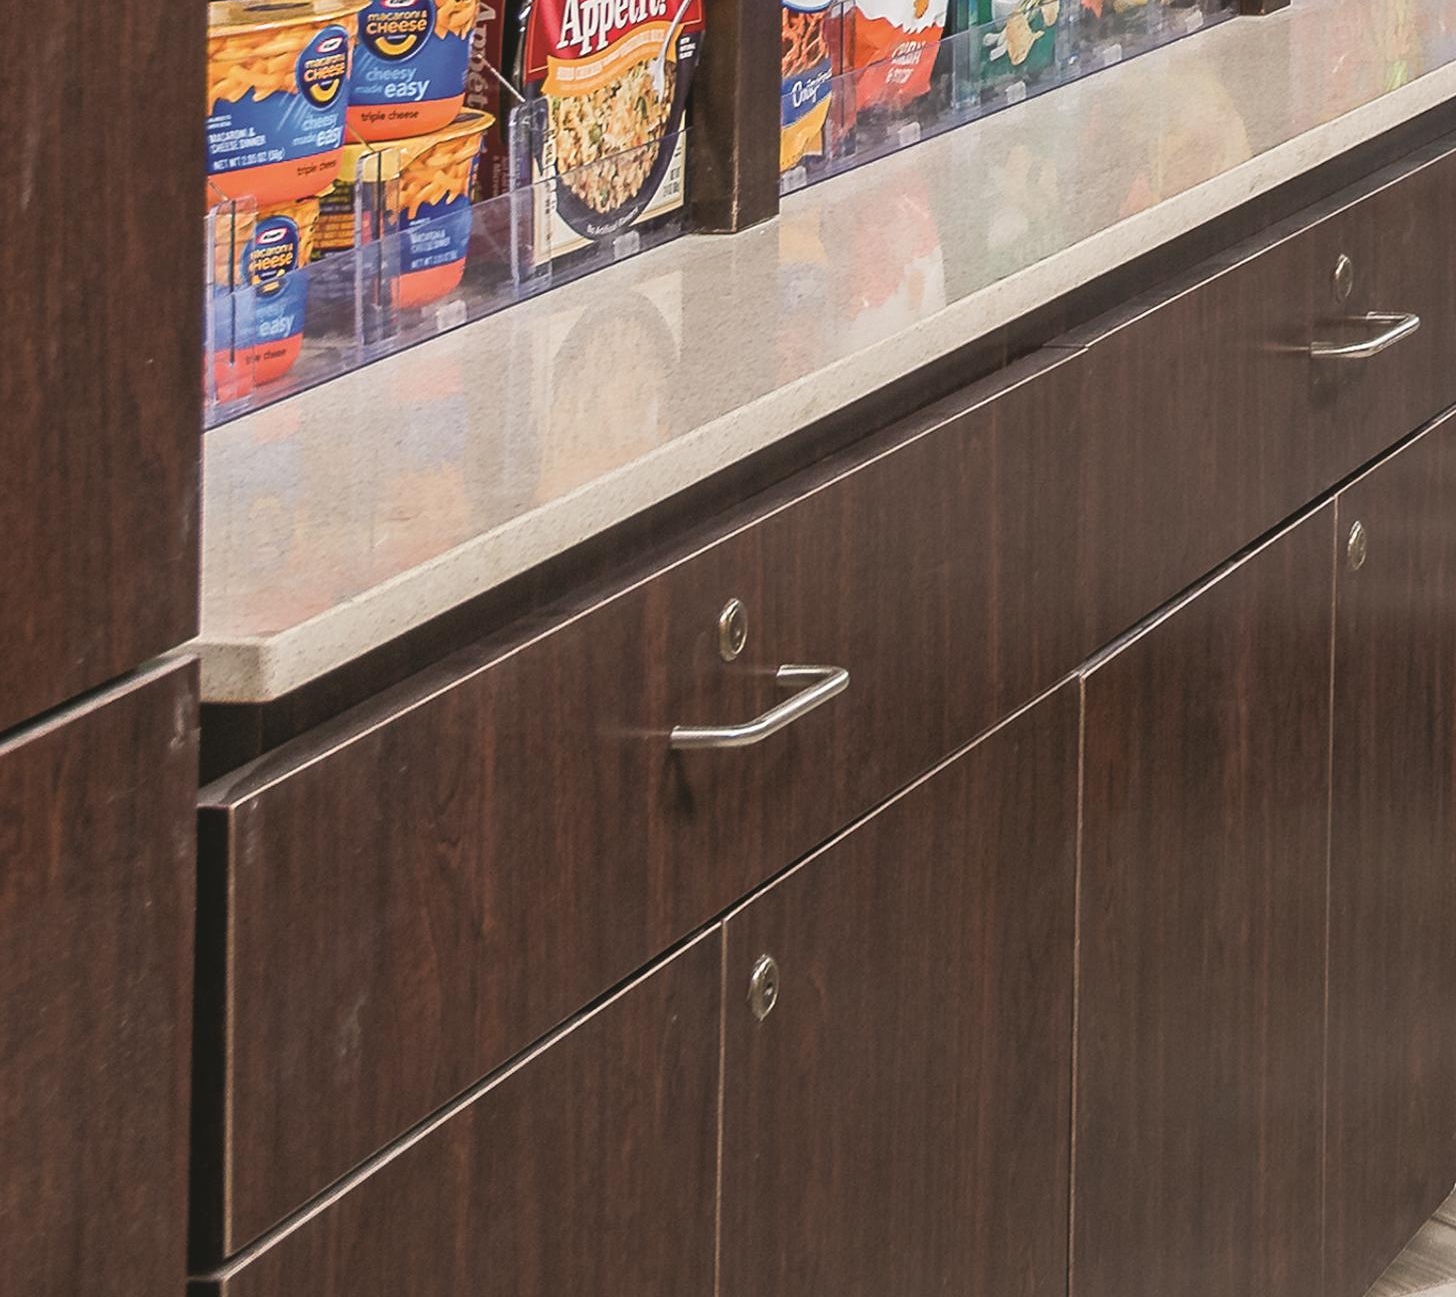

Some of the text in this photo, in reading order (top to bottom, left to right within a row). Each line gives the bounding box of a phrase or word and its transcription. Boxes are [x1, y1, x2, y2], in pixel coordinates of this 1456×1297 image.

[366, 66, 416, 83] cheesy
[361, 110, 418, 123] triple cheese
